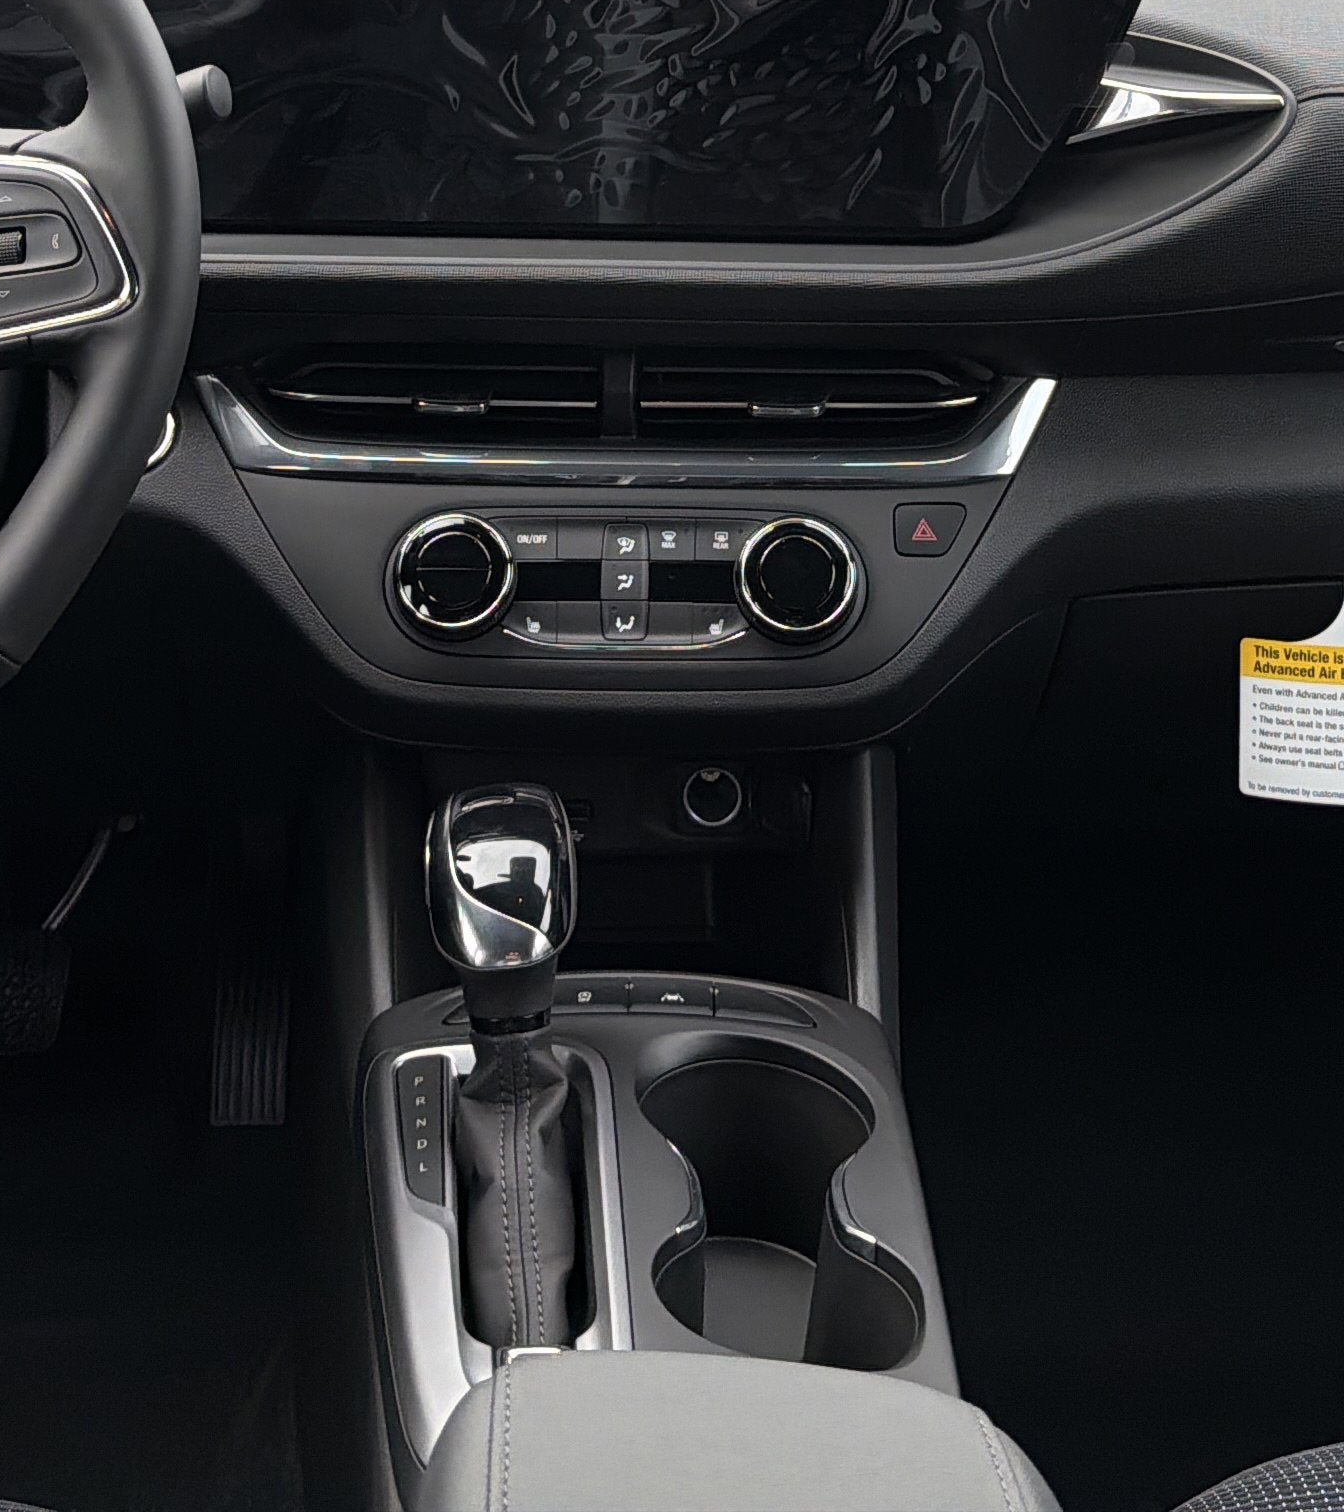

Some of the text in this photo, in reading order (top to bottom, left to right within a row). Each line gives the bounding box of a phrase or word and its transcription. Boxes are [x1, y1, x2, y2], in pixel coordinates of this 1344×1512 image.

[516, 534, 548, 545] ON/OFF
[661, 541, 676, 549] MAX
[1253, 644, 1280, 659] This
[1283, 647, 1330, 663] Vehicle
[1333, 651, 1344, 664] is
[1253, 659, 1315, 678] Advanced
[1318, 667, 1337, 679] Air
[1252, 684, 1273, 695] Even
[1274, 687, 1293, 697] with
[1295, 688, 1338, 701] Advanced
[1258, 714, 1274, 725] The
[414, 1076, 424, 1087] P
[415, 1096, 426, 1107] R
[416, 1117, 427, 1129] N
[416, 1138, 428, 1150] D
[419, 1161, 429, 1173] L
